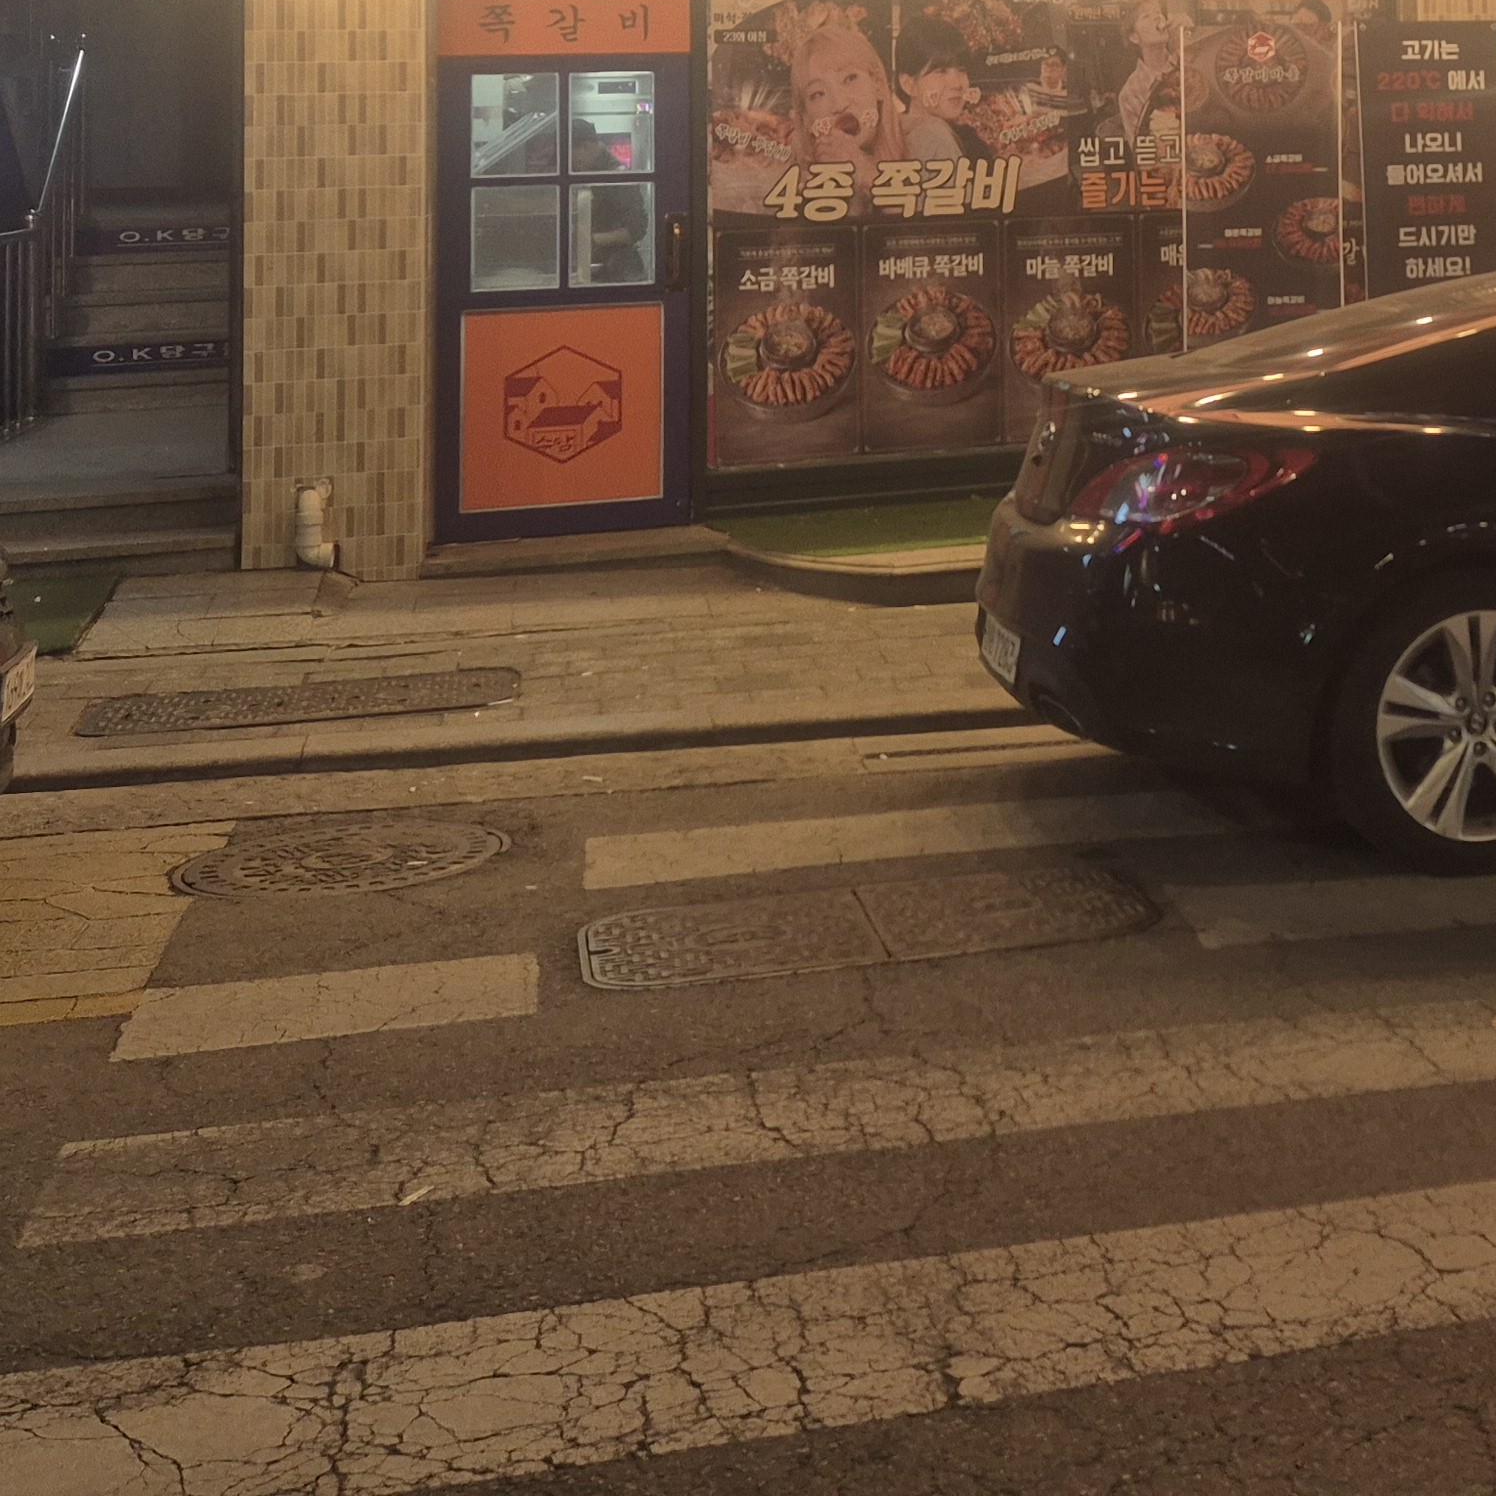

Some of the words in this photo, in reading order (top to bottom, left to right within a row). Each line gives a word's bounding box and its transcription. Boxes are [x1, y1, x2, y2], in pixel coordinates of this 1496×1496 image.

[477, 4, 652, 43] 쪽갈비
[1400, 40, 1460, 62] 고기는
[1447, 69, 1486, 92] 에서
[1077, 136, 1126, 167] 씹고
[1135, 133, 1181, 165] 뜯고
[1404, 132, 1464, 155] 나오니
[764, 160, 855, 222] 4종
[870, 154, 1023, 219] 쪽갈비
[1080, 169, 1169, 209] 즐기는
[1398, 223, 1478, 248] 드시기만
[738, 267, 778, 292] 소금
[780, 263, 836, 291] 쪽갈비
[878, 257, 930, 281] 바베큐
[933, 252, 984, 278] 쪽갈비
[1025, 257, 1062, 281] 마늘
[1063, 253, 1115, 278] 쪽갈비
[1404, 255, 1473, 281] 하세요!
